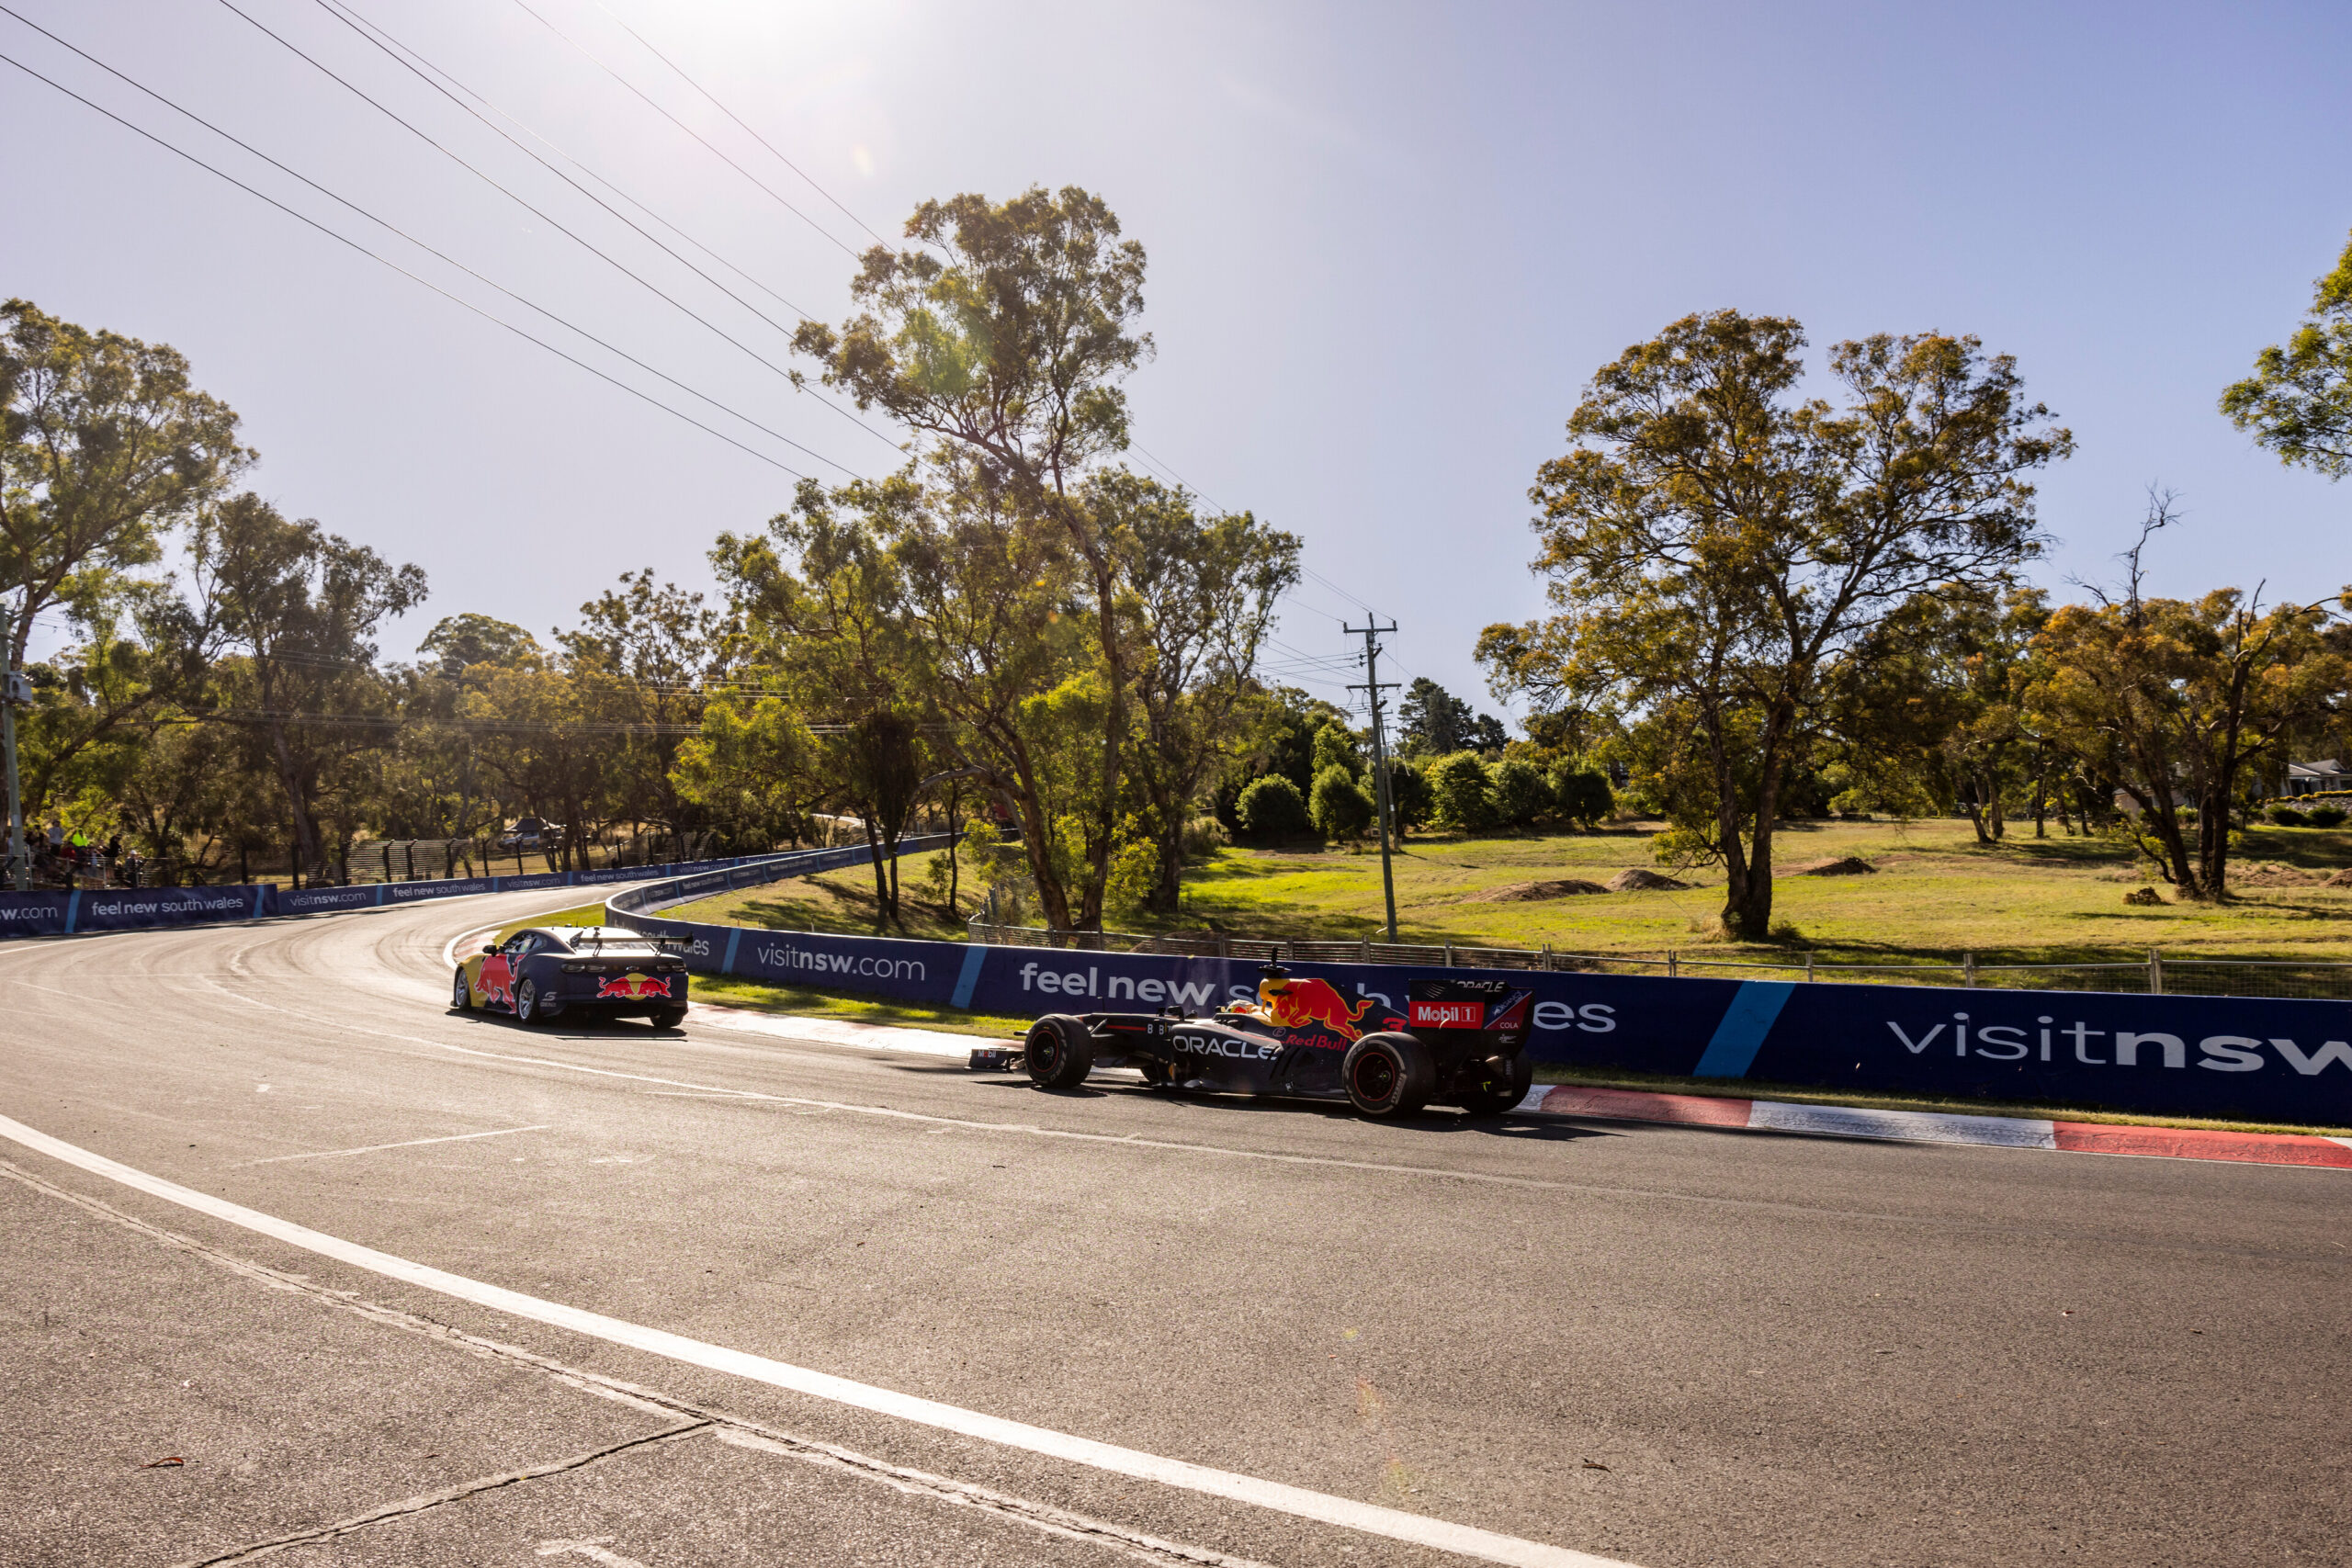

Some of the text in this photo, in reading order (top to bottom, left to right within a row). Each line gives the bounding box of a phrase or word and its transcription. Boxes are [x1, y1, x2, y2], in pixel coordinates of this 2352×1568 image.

[507, 876, 560, 888] visitnsw.com
[581, 874, 596, 882] feel
[392, 883, 485, 897] feel new south wales
[92, 897, 243, 916] feel new south wales
[289, 891, 367, 907] visitnsw.com
[0, 907, 58, 920] w.com
[757, 942, 925, 981] visitnsw.com
[1019, 962, 1098, 997] feel
[1108, 976, 1216, 1007] new
[1418, 1006, 1459, 1021] Mobil
[1382, 1017, 1407, 1032] 3
[1172, 1035, 1277, 1061] ORACLE
[1286, 1033, 1348, 1052] Red Bull
[978, 1050, 997, 1058] Mobil
